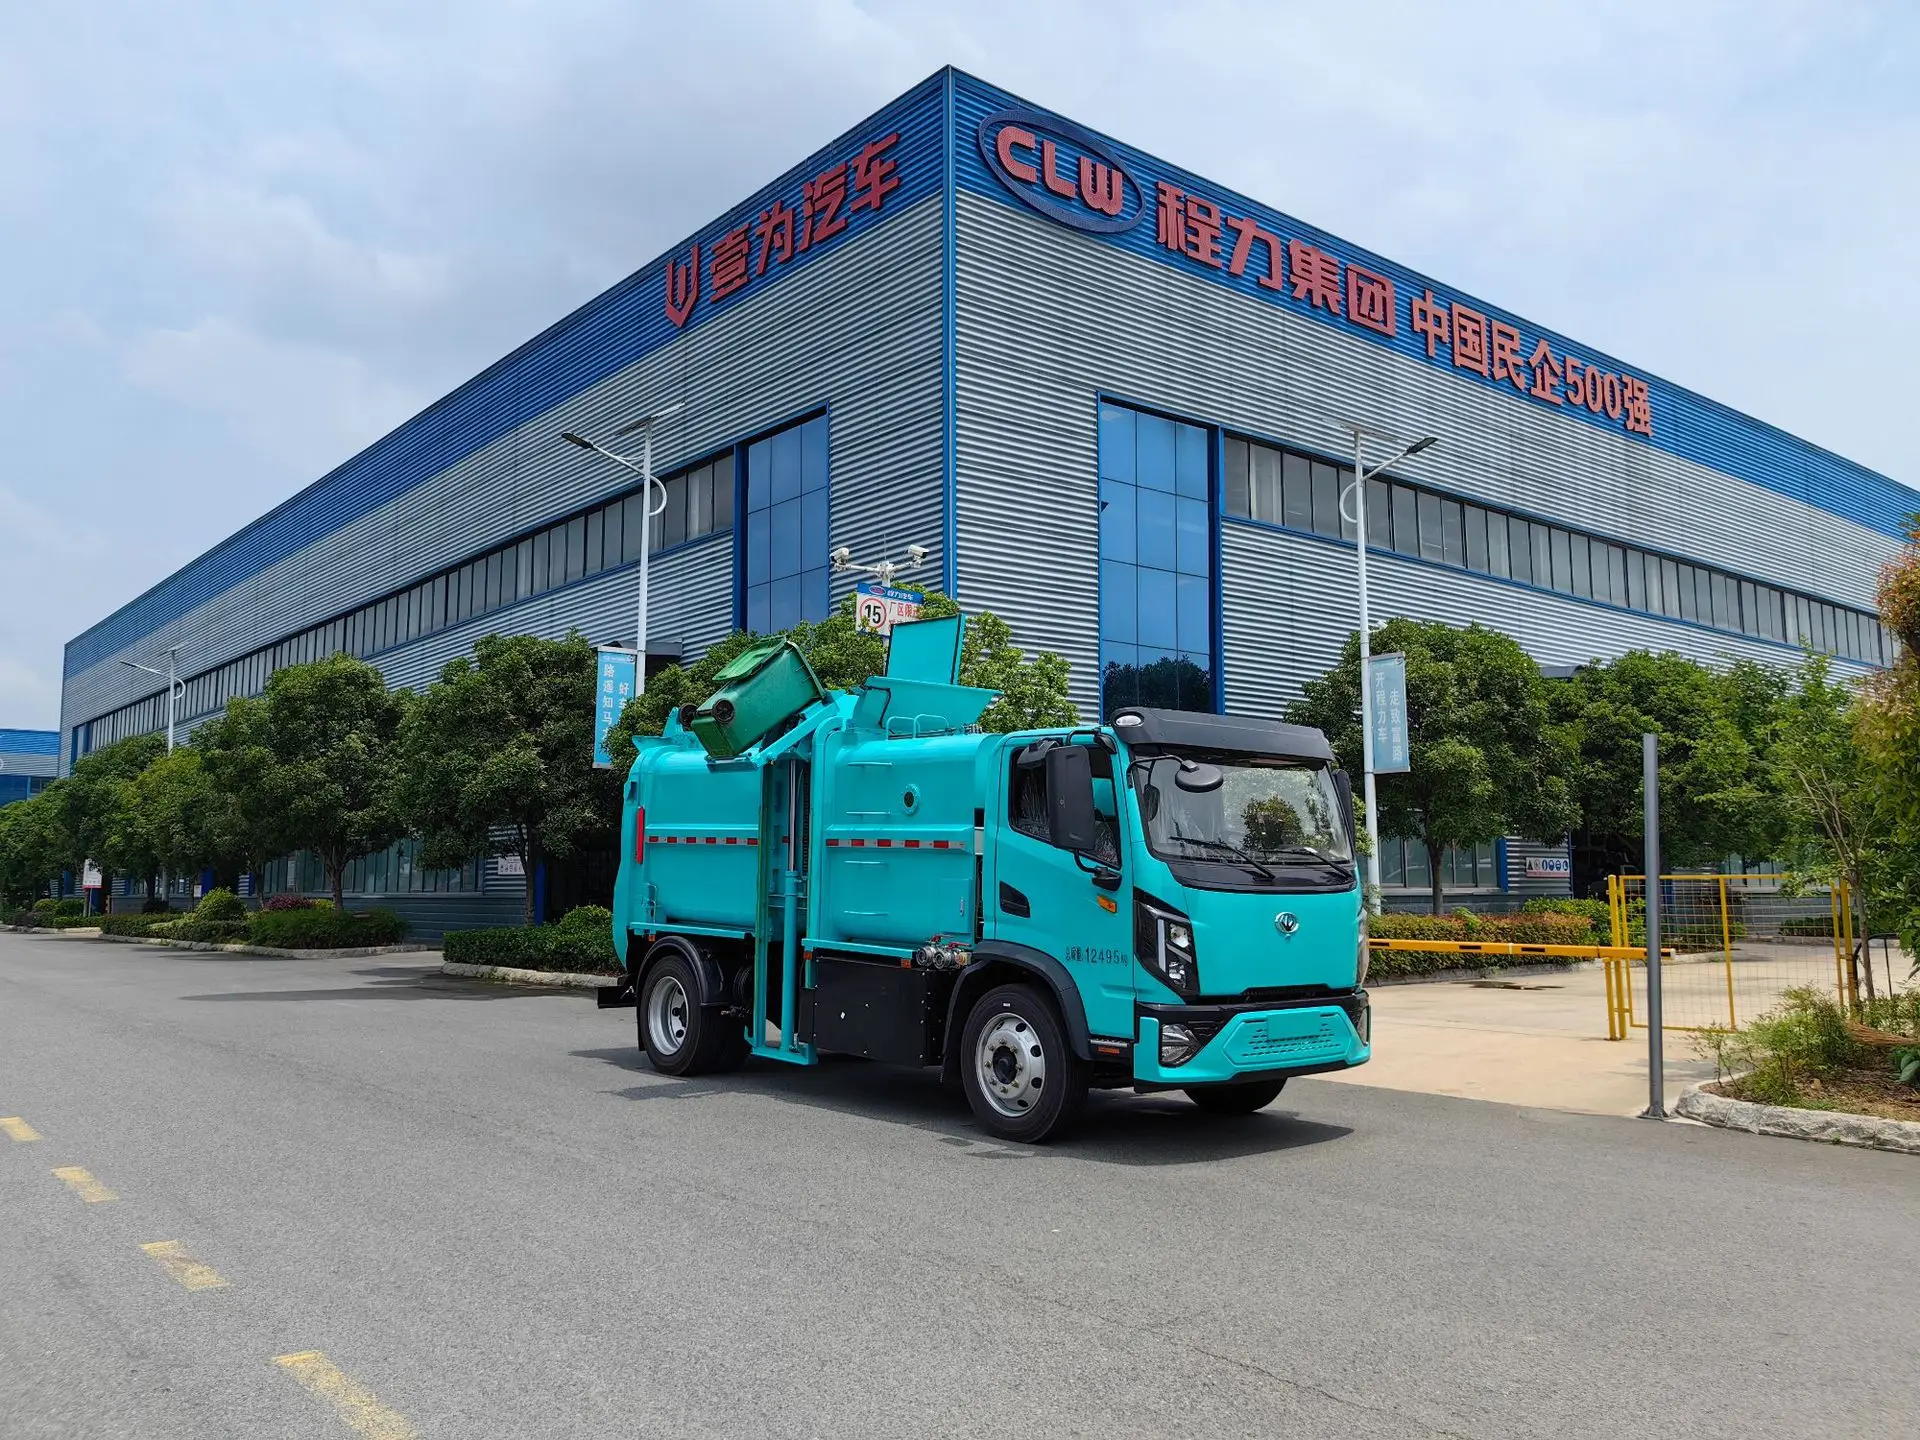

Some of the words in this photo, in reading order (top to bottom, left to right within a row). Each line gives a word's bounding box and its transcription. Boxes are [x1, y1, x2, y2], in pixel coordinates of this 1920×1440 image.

[708, 132, 902, 303] 壹为汽车
[996, 125, 1124, 217] CLW
[1156, 180, 1396, 337] 程力集团
[1412, 289, 1653, 437] 中国民企500强
[865, 604, 881, 624] 15
